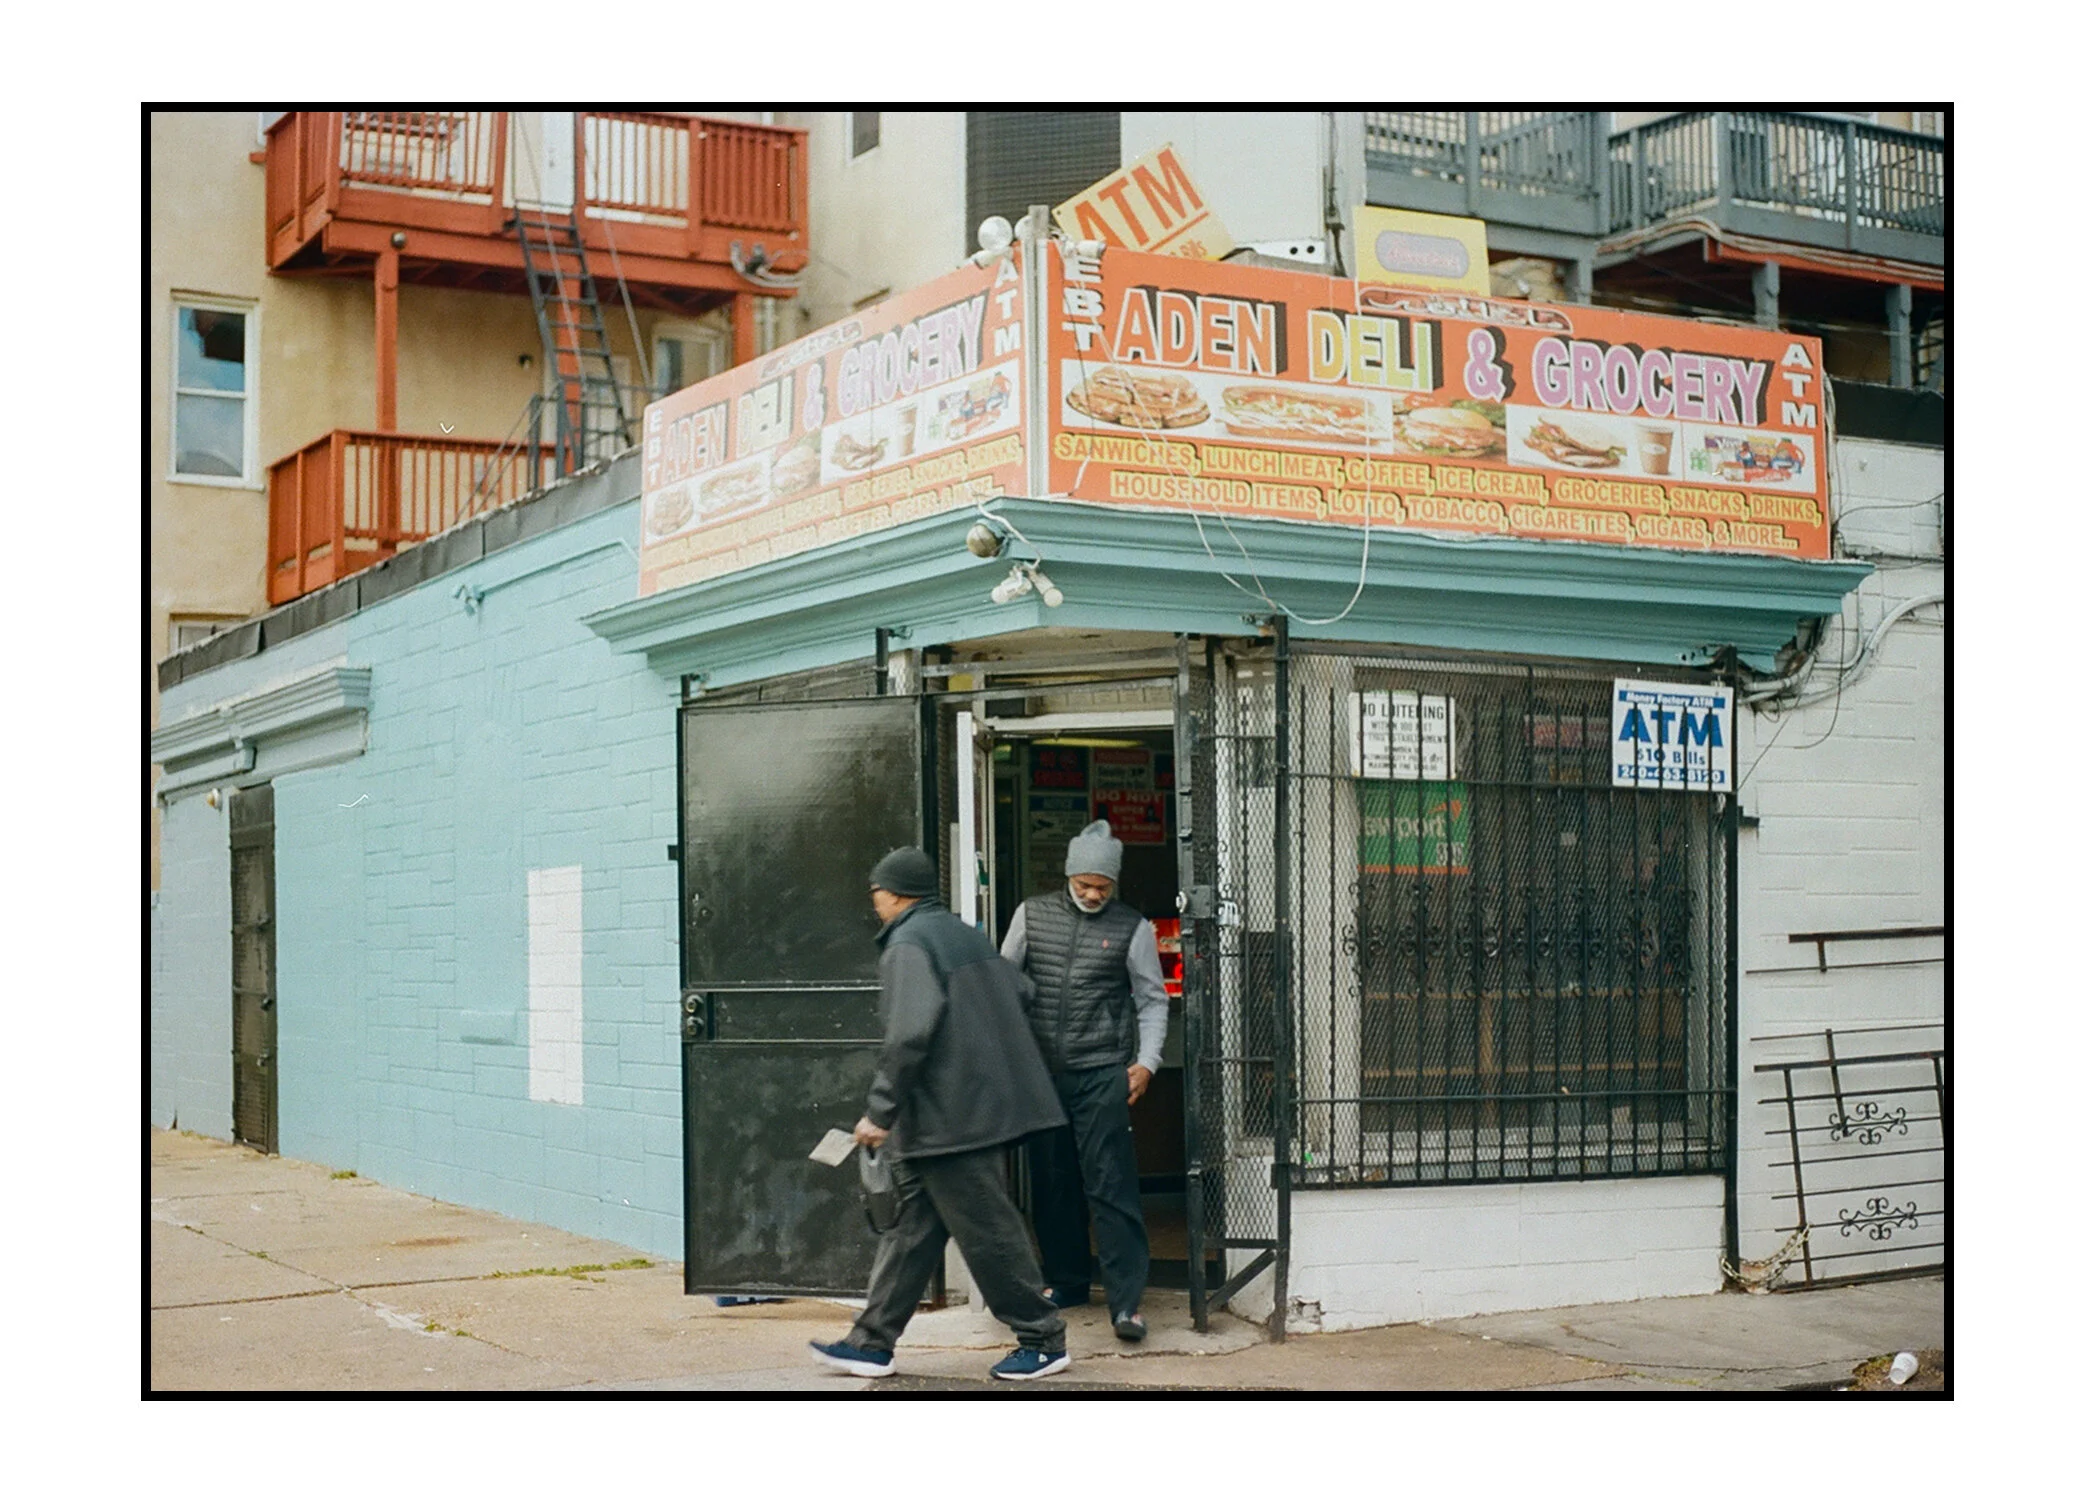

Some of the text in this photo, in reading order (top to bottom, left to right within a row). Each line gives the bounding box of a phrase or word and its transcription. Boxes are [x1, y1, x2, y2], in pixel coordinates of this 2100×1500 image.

[1075, 147, 1203, 252] ATM
[993, 260, 1022, 357] ATM
[1063, 256, 1103, 352] EBT
[663, 294, 987, 486] ADEN DELI & GROCERY
[1113, 287, 1768, 428] ADEN DELI & GROCERY
[1780, 343, 1818, 429] ATM
[647, 408, 664, 486] EBT
[1054, 431, 1823, 528] SANWICHES, LUNCH MEAT, COFFEE, ICE CREAM, GROCERIES, SNACKS, DRINKS,
[1110, 469, 1252, 508] HOUSEHOLD
[1252, 483, 1329, 521] ITEMS,
[1328, 489, 1407, 525] LOTTO,
[1406, 493, 1510, 534] TOBACCO,
[1509, 506, 1637, 544] CIGARETTES,
[1636, 515, 1714, 549] CIGARS,
[1713, 520, 1733, 546] &
[1618, 708, 1723, 748] ATM
[1626, 691, 1714, 708] Money Factory ATM
[1672, 750, 1706, 766] Blls
[1359, 816, 1447, 843] ewport
